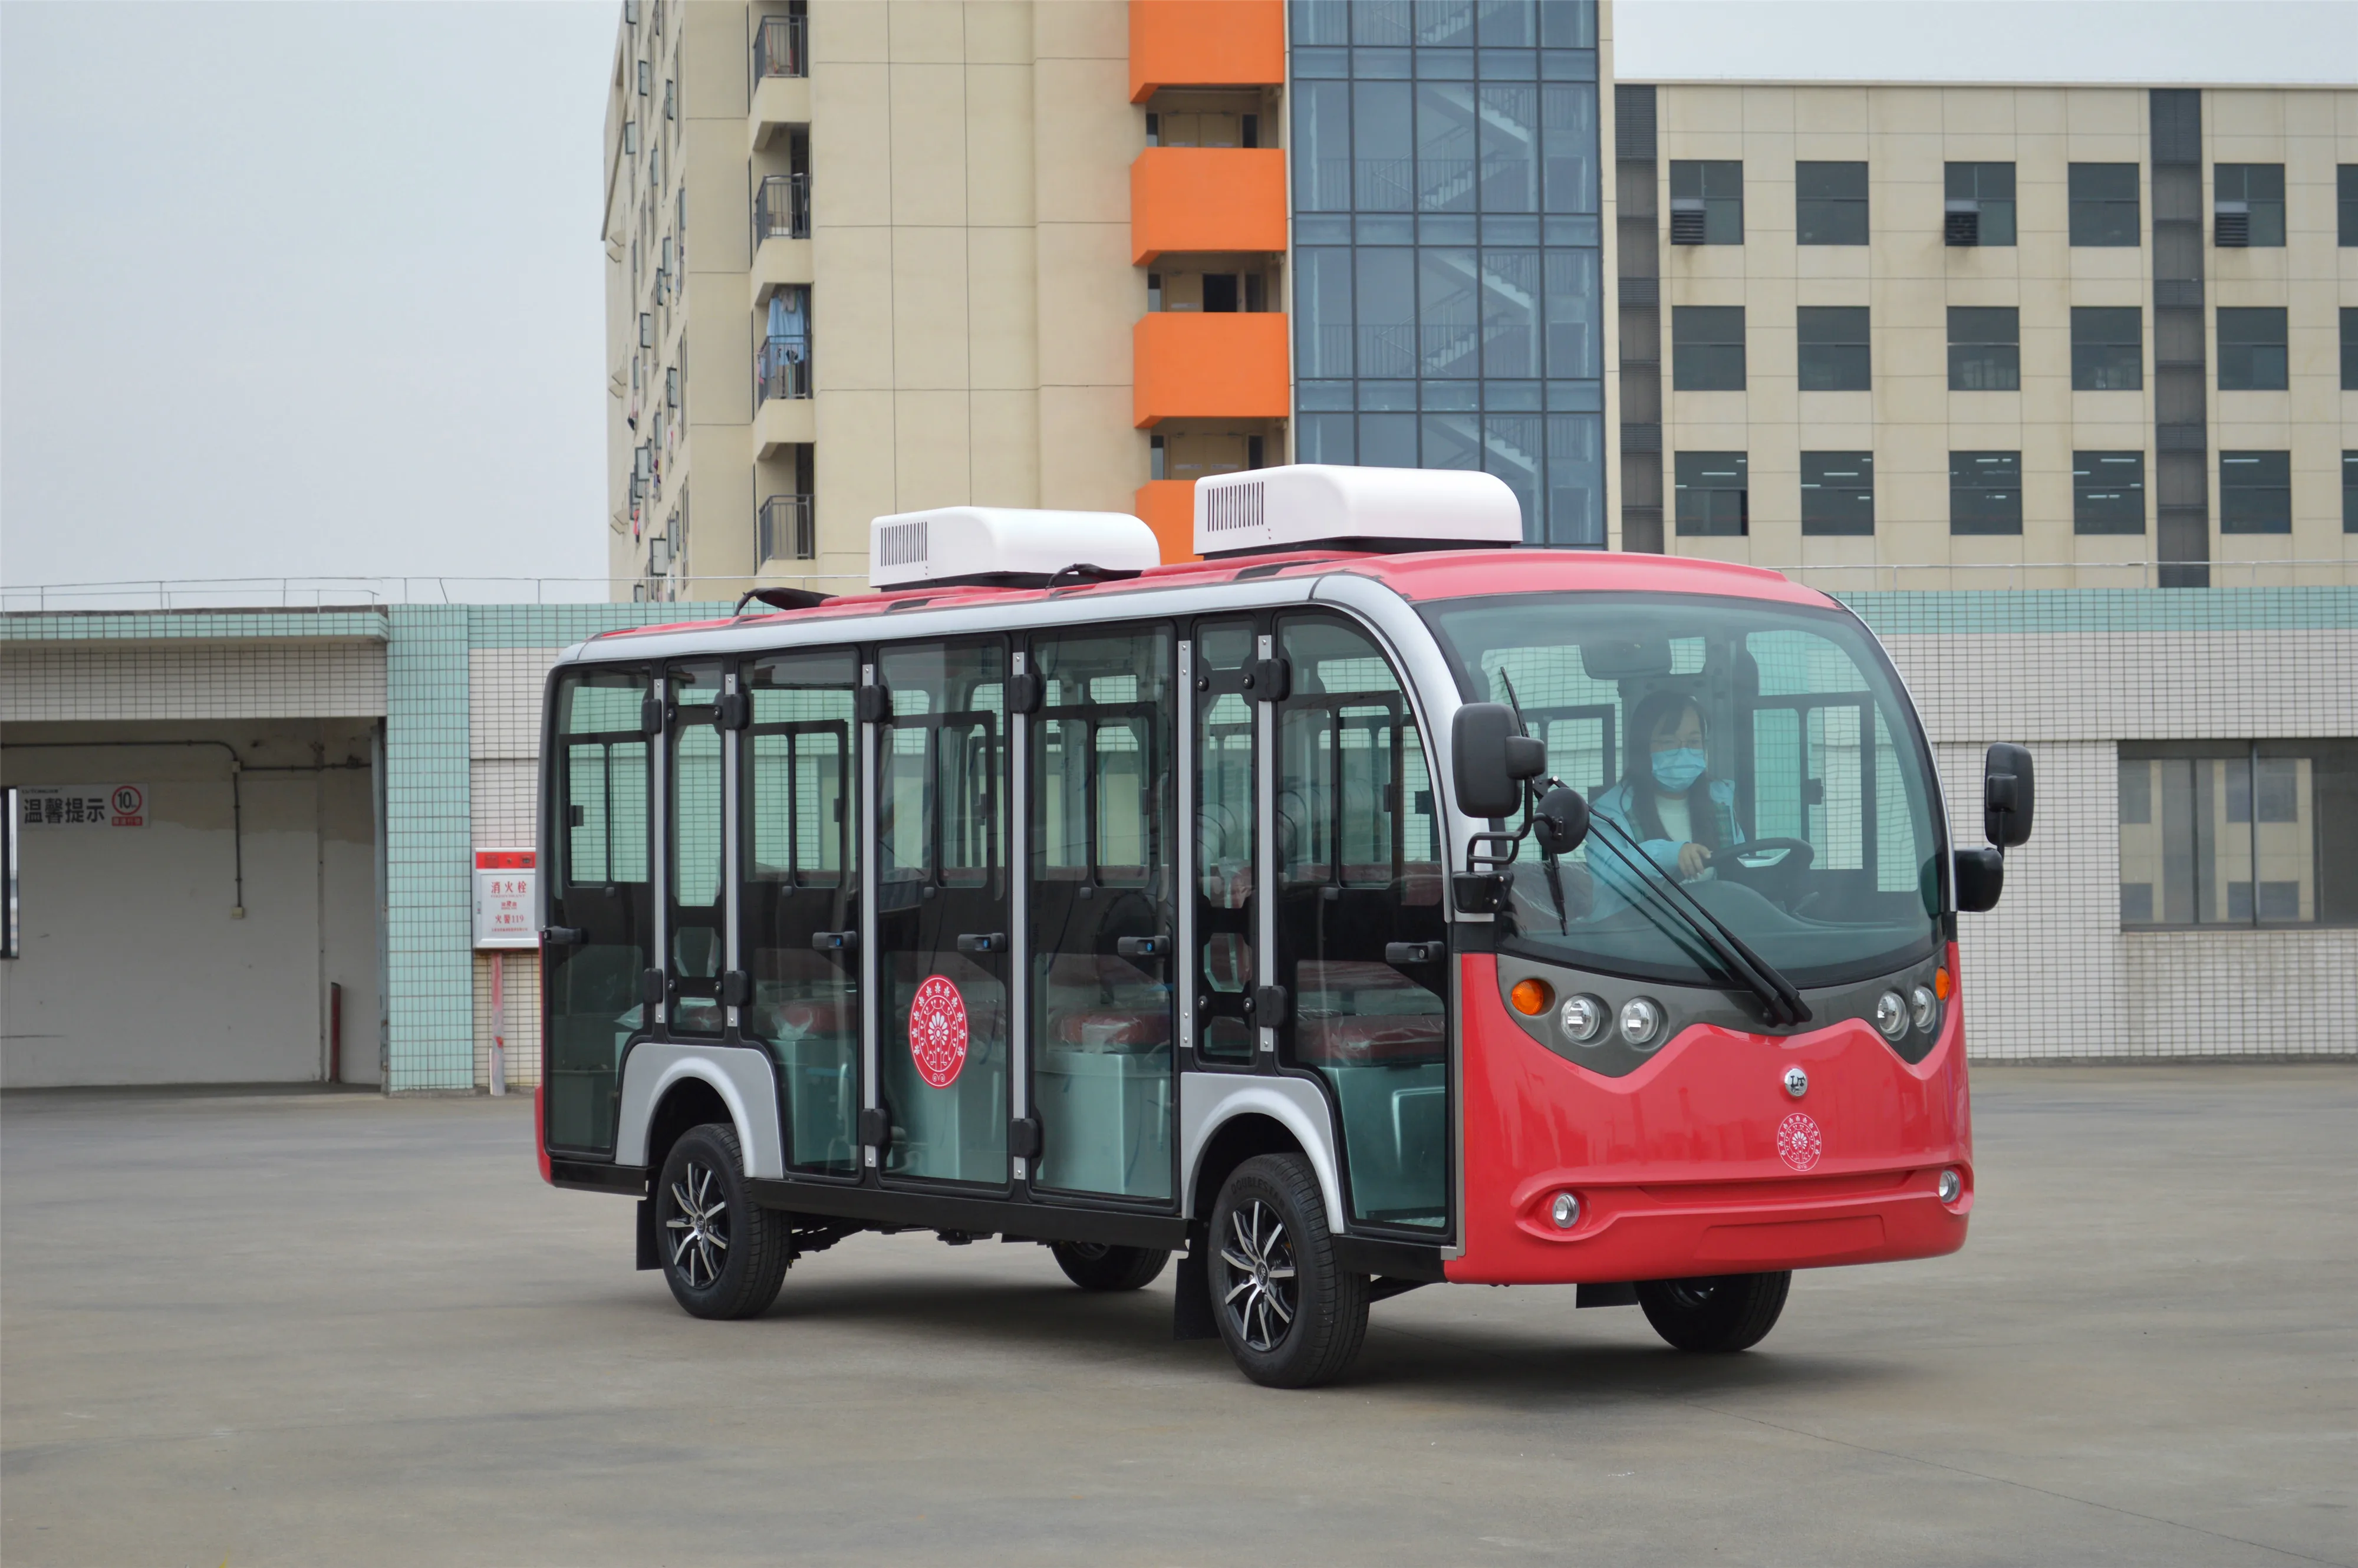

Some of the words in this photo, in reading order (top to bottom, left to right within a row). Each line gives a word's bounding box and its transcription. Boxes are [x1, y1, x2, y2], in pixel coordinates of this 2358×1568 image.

[117, 791, 132, 809] 10
[24, 798, 105, 824] 温馨提示
[491, 881, 526, 894] 消火栓
